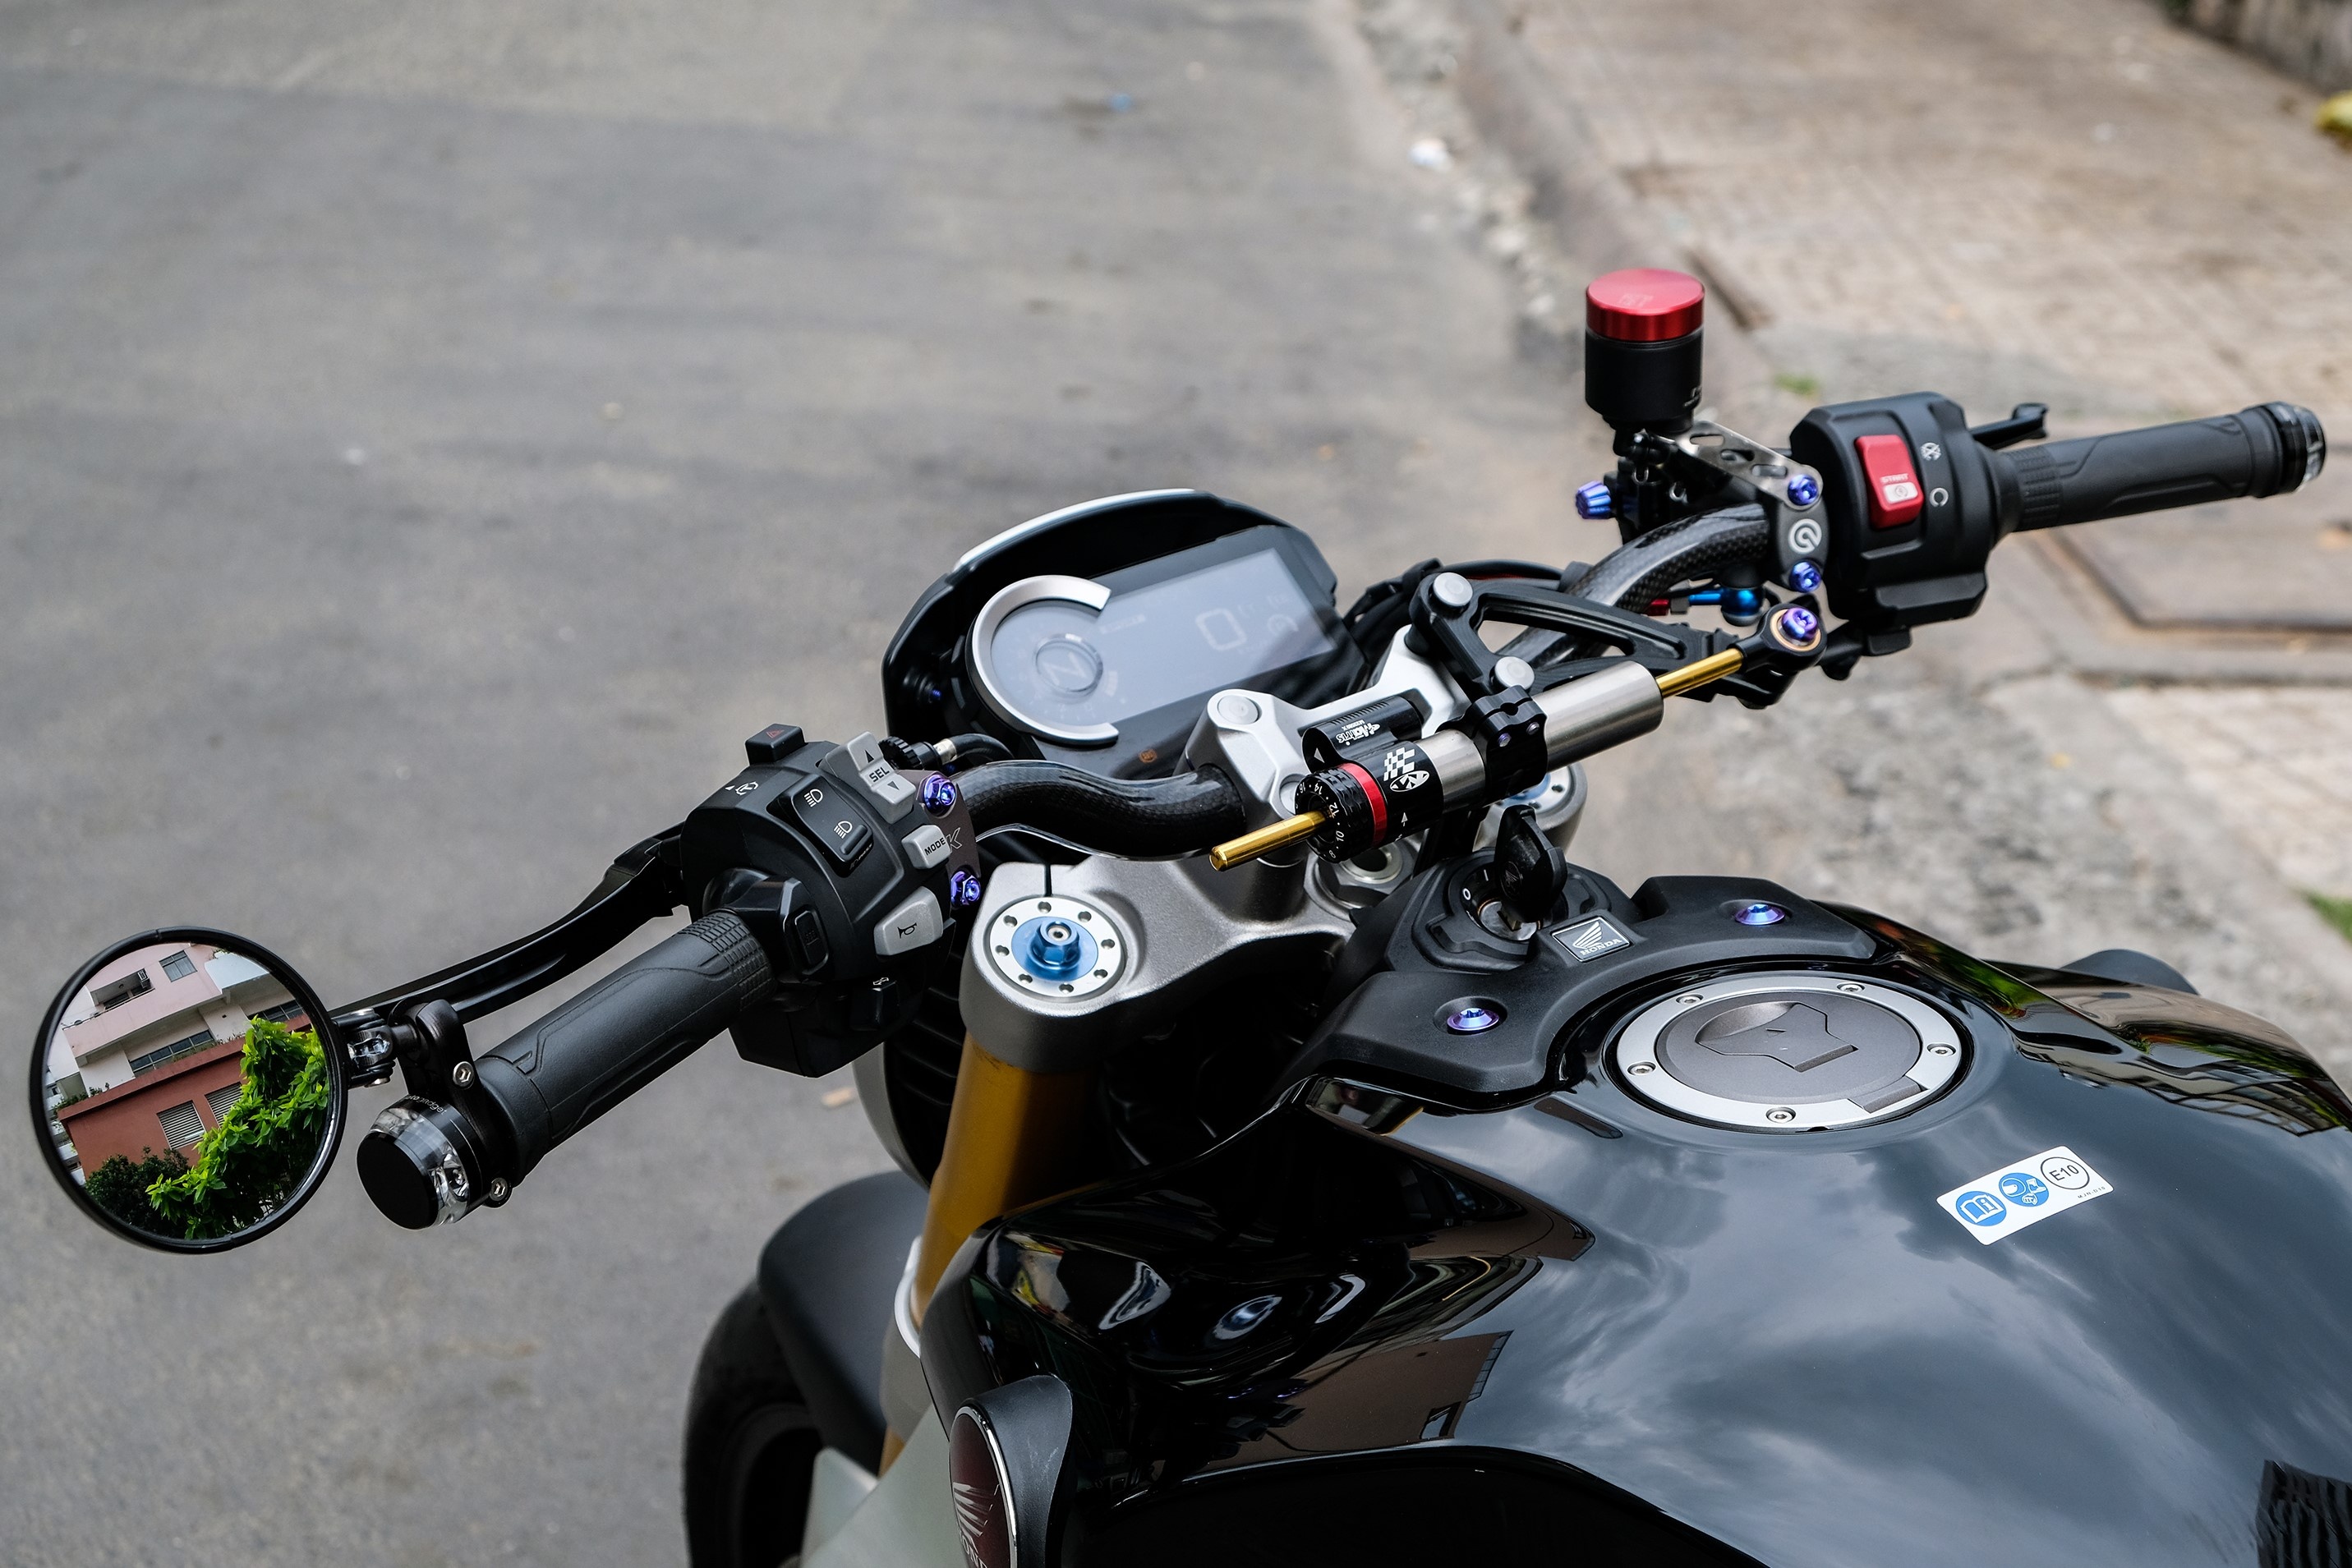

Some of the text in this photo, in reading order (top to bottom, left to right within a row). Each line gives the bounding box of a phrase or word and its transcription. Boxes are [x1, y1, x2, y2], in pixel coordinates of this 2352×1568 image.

[869, 766, 890, 783] SEL
[1314, 783, 1323, 794] 14
[1336, 830, 1345, 842] 10
[924, 838, 946, 856] MODE
[1580, 938, 1623, 955] HONDA
[2049, 1165, 2079, 1181] E10
